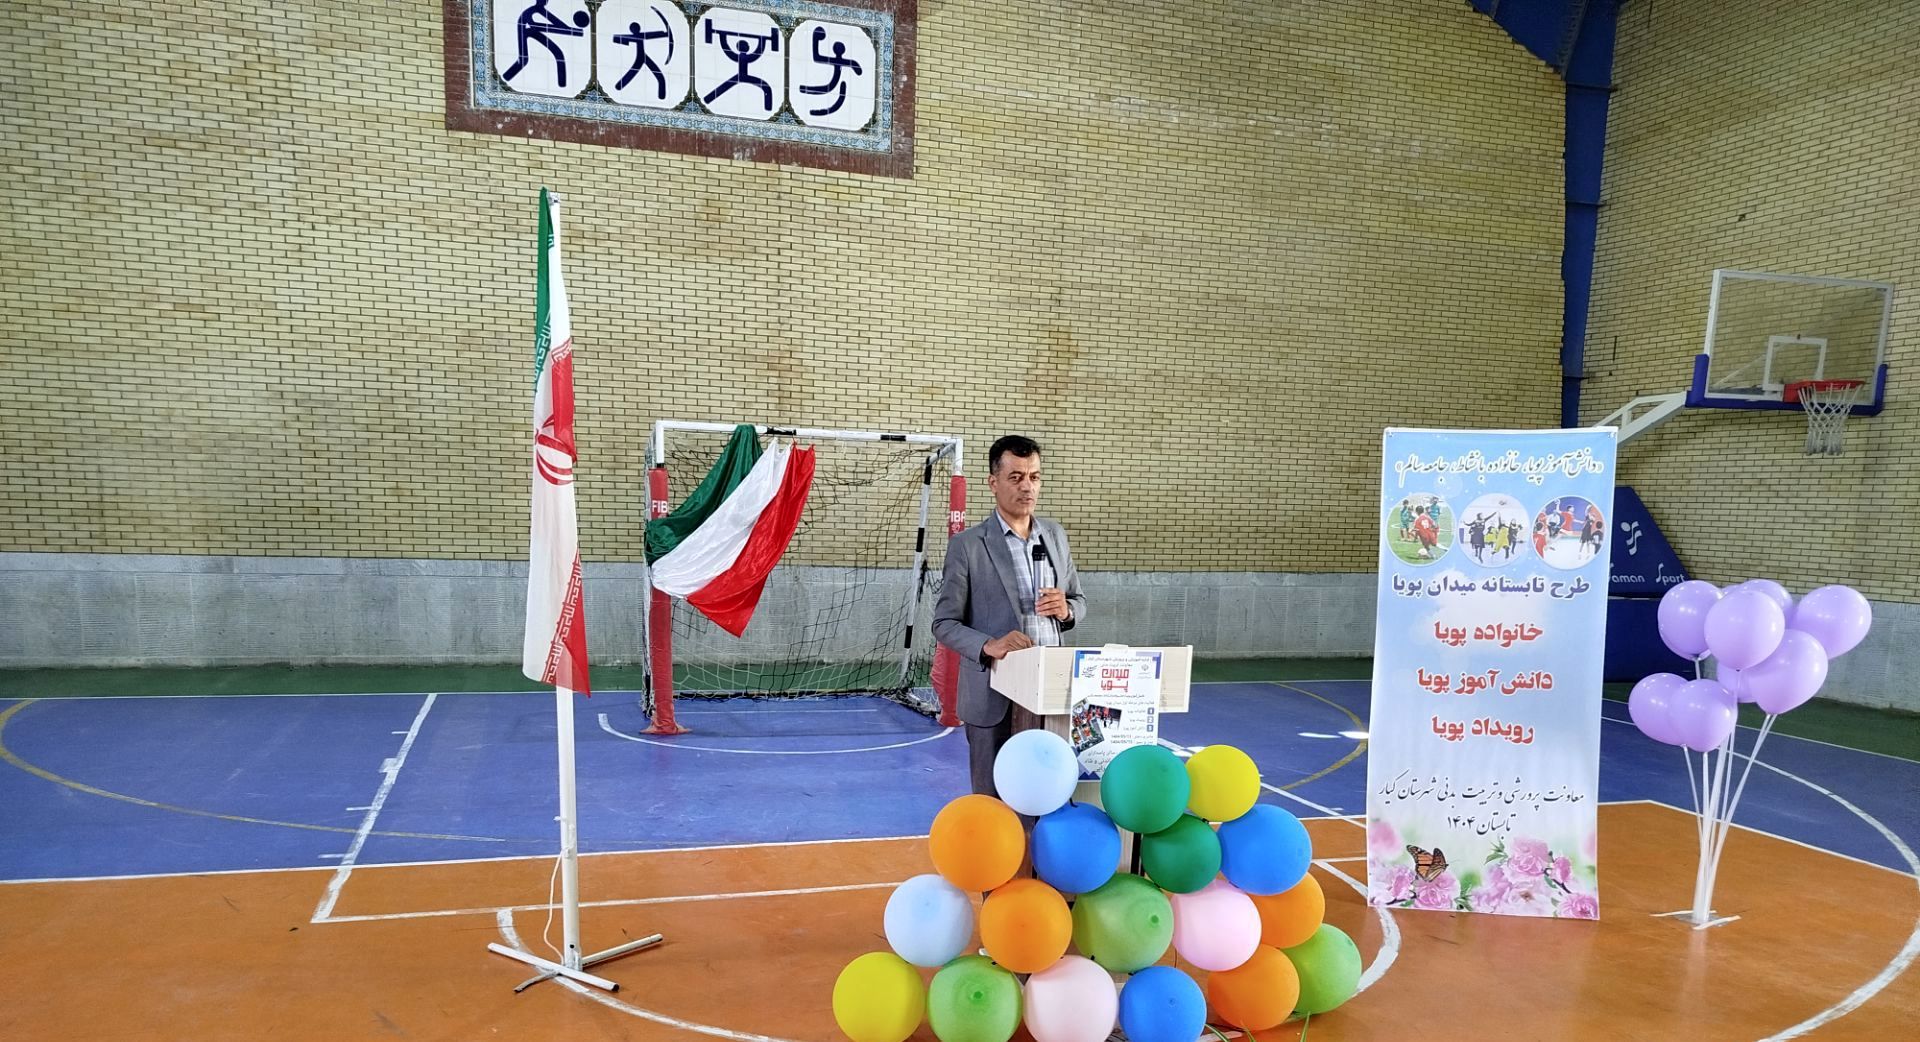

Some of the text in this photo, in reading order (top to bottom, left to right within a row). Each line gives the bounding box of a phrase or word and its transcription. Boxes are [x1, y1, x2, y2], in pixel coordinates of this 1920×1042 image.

[1424, 456, 1449, 483] جامعه
[1487, 451, 1520, 473] خانواده
[1393, 573, 1590, 599] طرح تابستانه میدان پویا
[1434, 620, 1544, 648] خانواده پویا
[1418, 668, 1553, 695] دانش آموز پویا
[1432, 715, 1534, 744] رویداد پویا
[1378, 768, 1410, 804] کیار
[1397, 776, 1438, 801] شهرستان
[1437, 776, 1457, 809] بدنی
[1462, 781, 1498, 806] تربیت
[1504, 777, 1541, 811] پرورشی
[1543, 785, 1584, 803] معاونت
[1446, 811, 1518, 841] تابستان ۱۴۰۴
